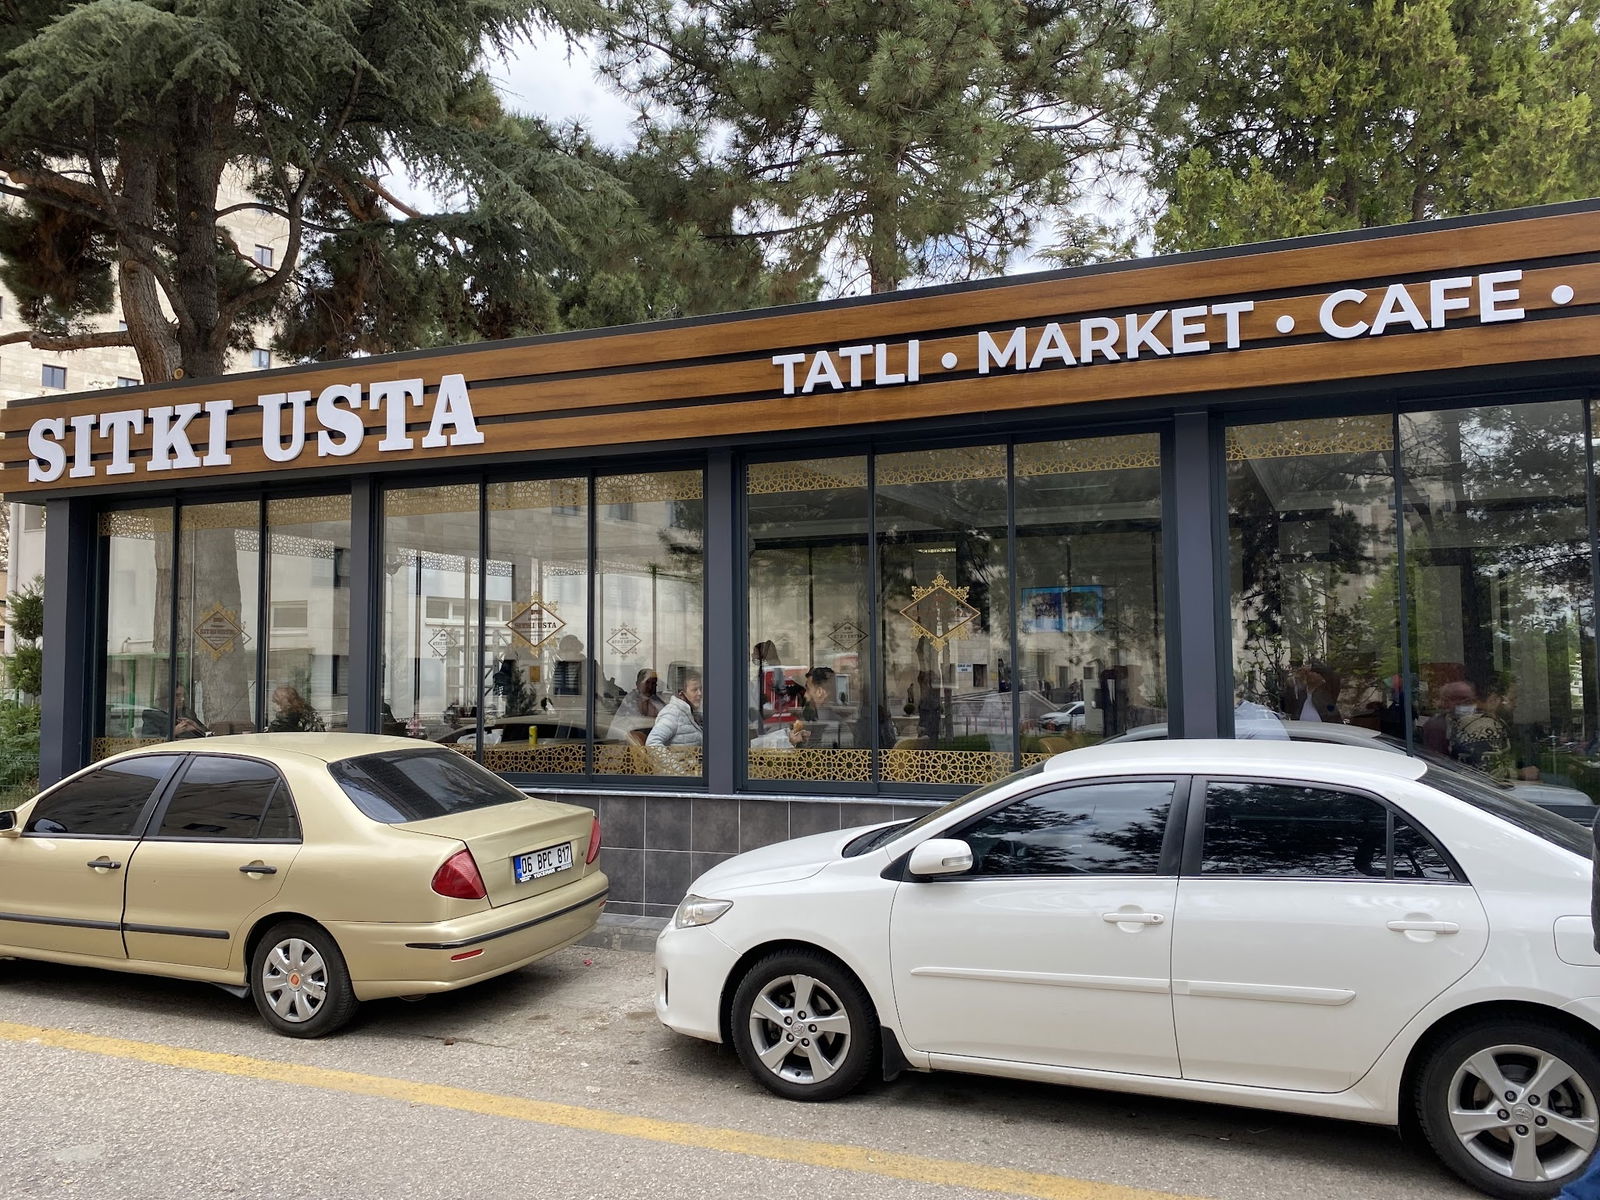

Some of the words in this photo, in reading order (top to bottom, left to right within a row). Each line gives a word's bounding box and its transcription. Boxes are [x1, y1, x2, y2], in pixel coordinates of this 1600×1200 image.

[772, 339, 921, 397] TATLI
[977, 300, 1256, 375] MARKET
[1318, 269, 1526, 340] CAFE
[27, 400, 234, 483] SITKI
[257, 373, 485, 462] USTA
[522, 857, 532, 874] 06
[537, 851, 552, 870] BPC
[557, 846, 569, 863] 817
